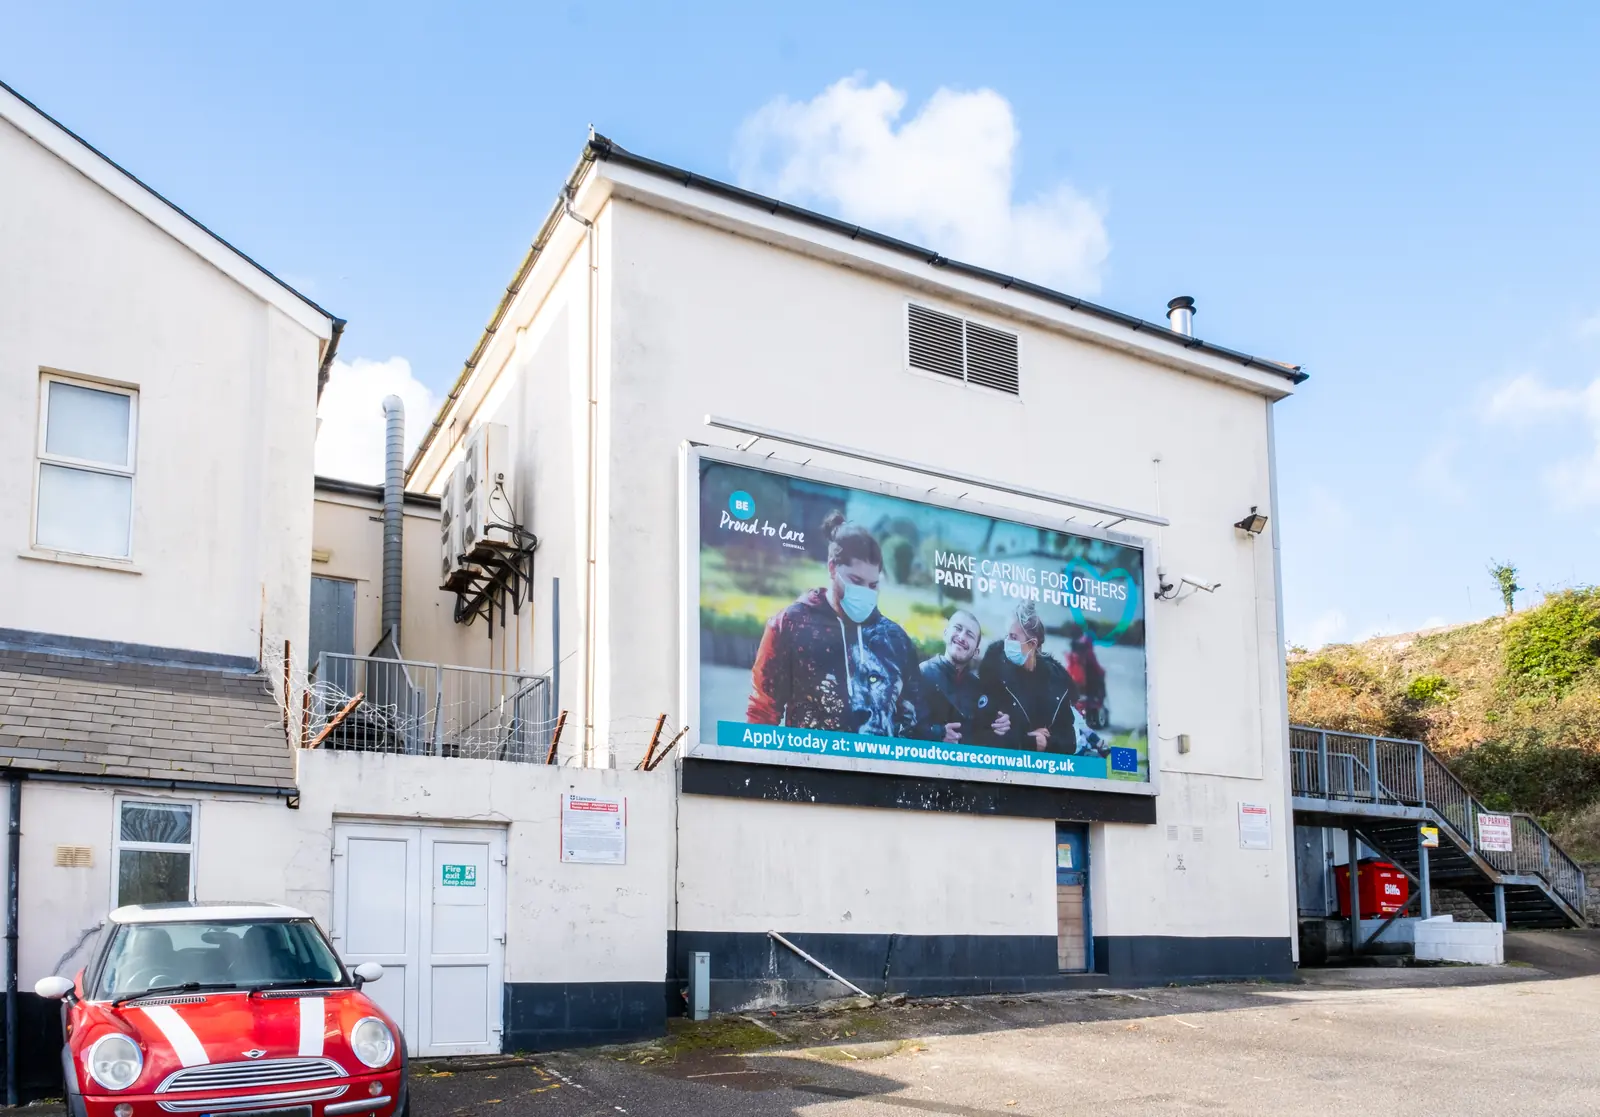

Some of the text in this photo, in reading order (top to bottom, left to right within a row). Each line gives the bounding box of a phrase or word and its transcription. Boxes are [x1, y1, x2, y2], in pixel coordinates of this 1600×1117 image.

[735, 500, 749, 511] BE
[719, 510, 805, 543] Proud to Care
[782, 542, 805, 551] CORNWALL
[934, 550, 1127, 601] MAKE CARING FOR OTHERS
[934, 569, 1102, 612] PART OF YOUR FUTURE.
[742, 728, 1076, 773] Apply today at: www.proudtocarecornwall.org.uk
[1479, 816, 1510, 827] NO PARKING
[445, 865, 461, 873] Fire
[443, 879, 460, 887] Keep
[1384, 883, 1401, 896] Biffa
